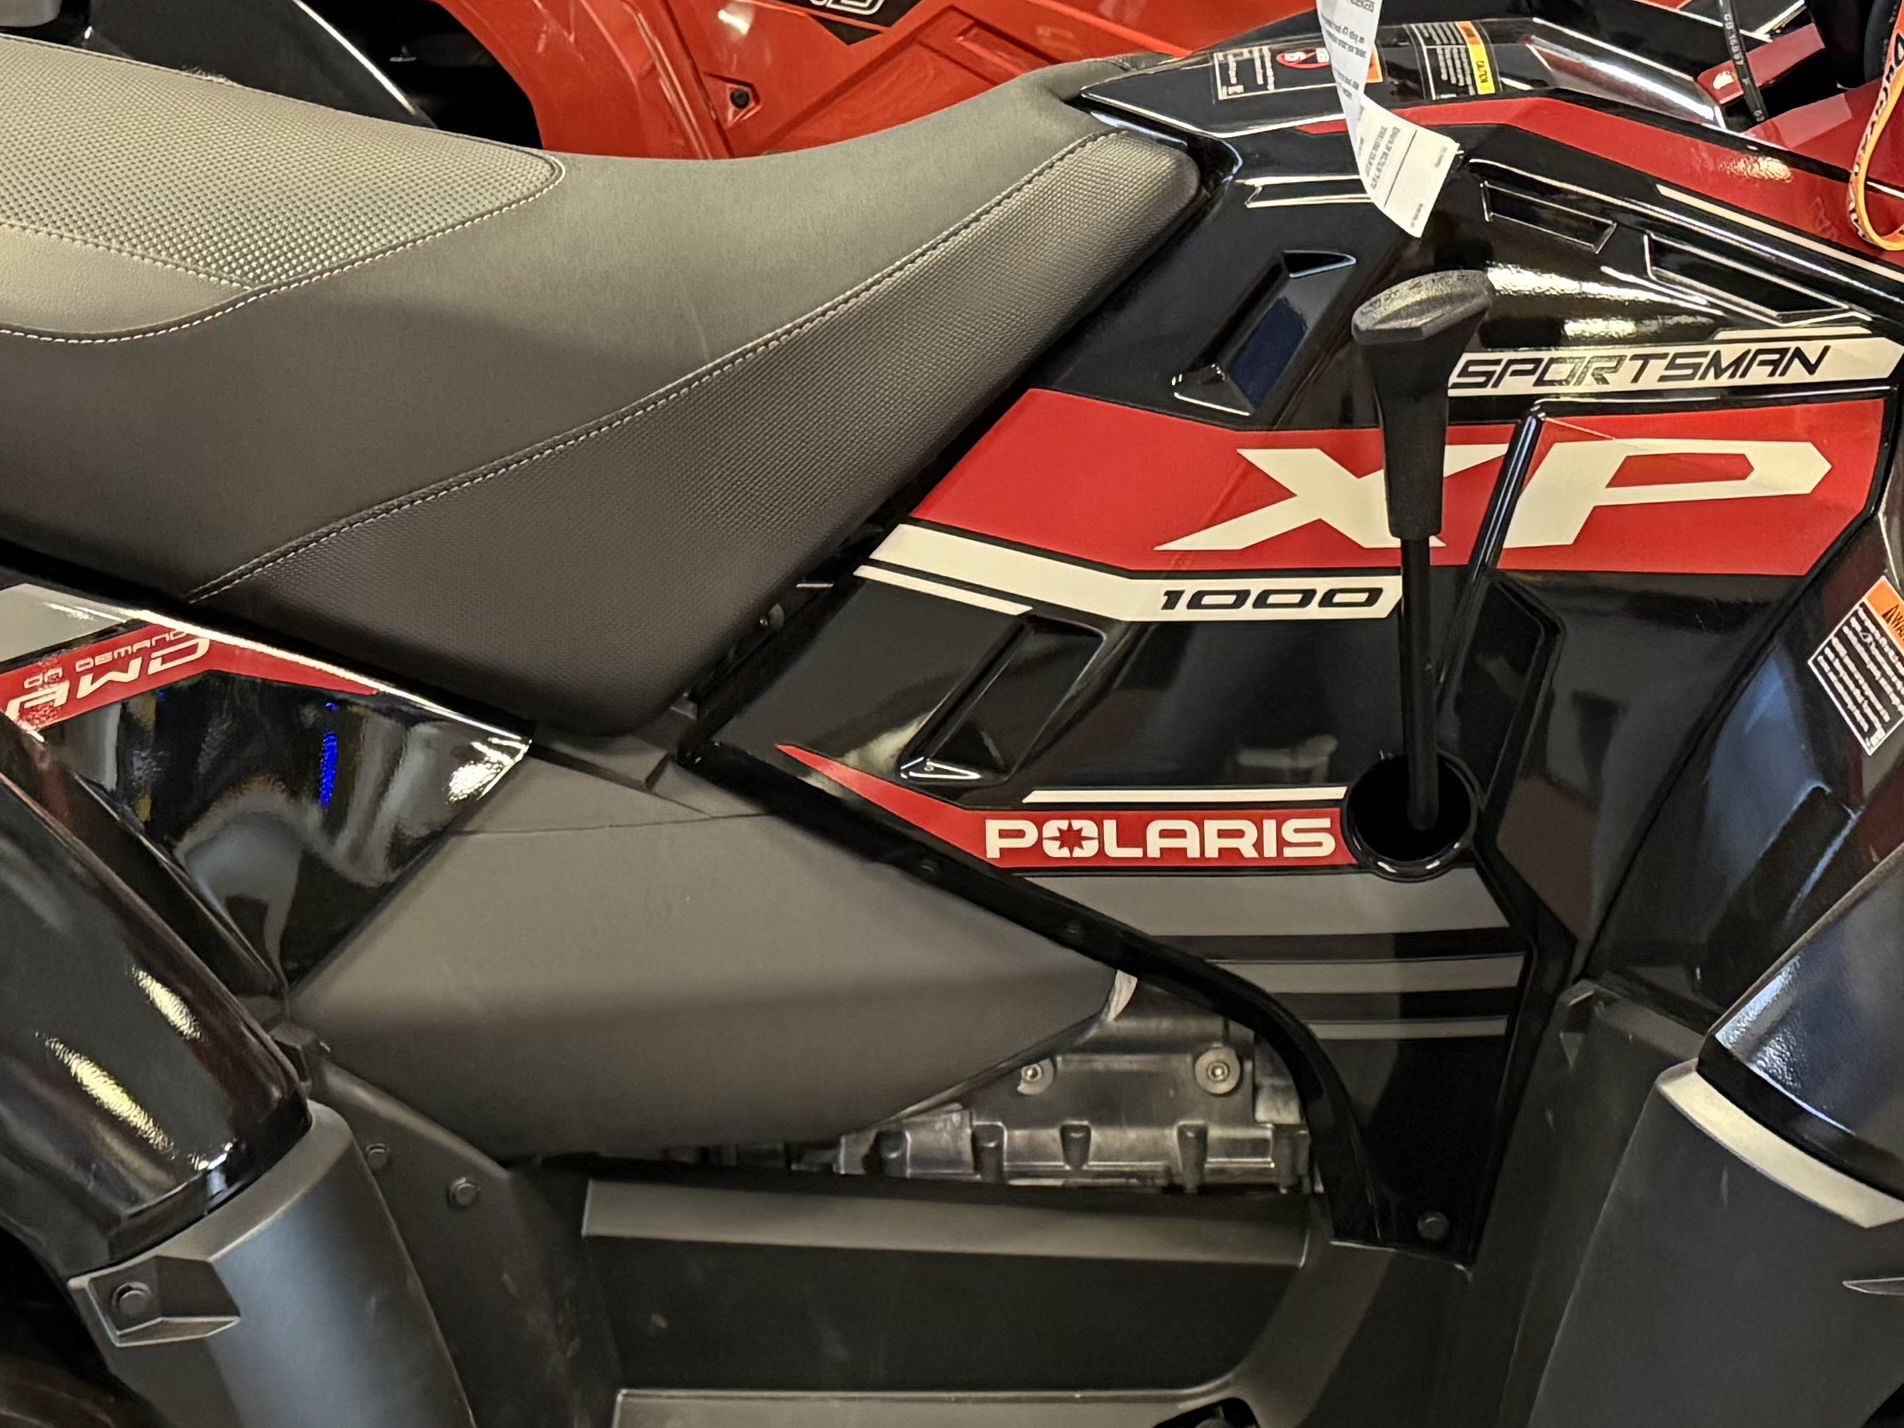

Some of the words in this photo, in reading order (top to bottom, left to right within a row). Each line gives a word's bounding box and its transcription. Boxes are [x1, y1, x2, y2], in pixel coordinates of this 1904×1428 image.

[1452, 343, 1832, 395] SPORTSMAN
[1152, 437, 1834, 551] XP
[1158, 587, 1385, 612] 1000
[6, 635, 213, 722] AWD
[985, 815, 1338, 860] POLARIS
